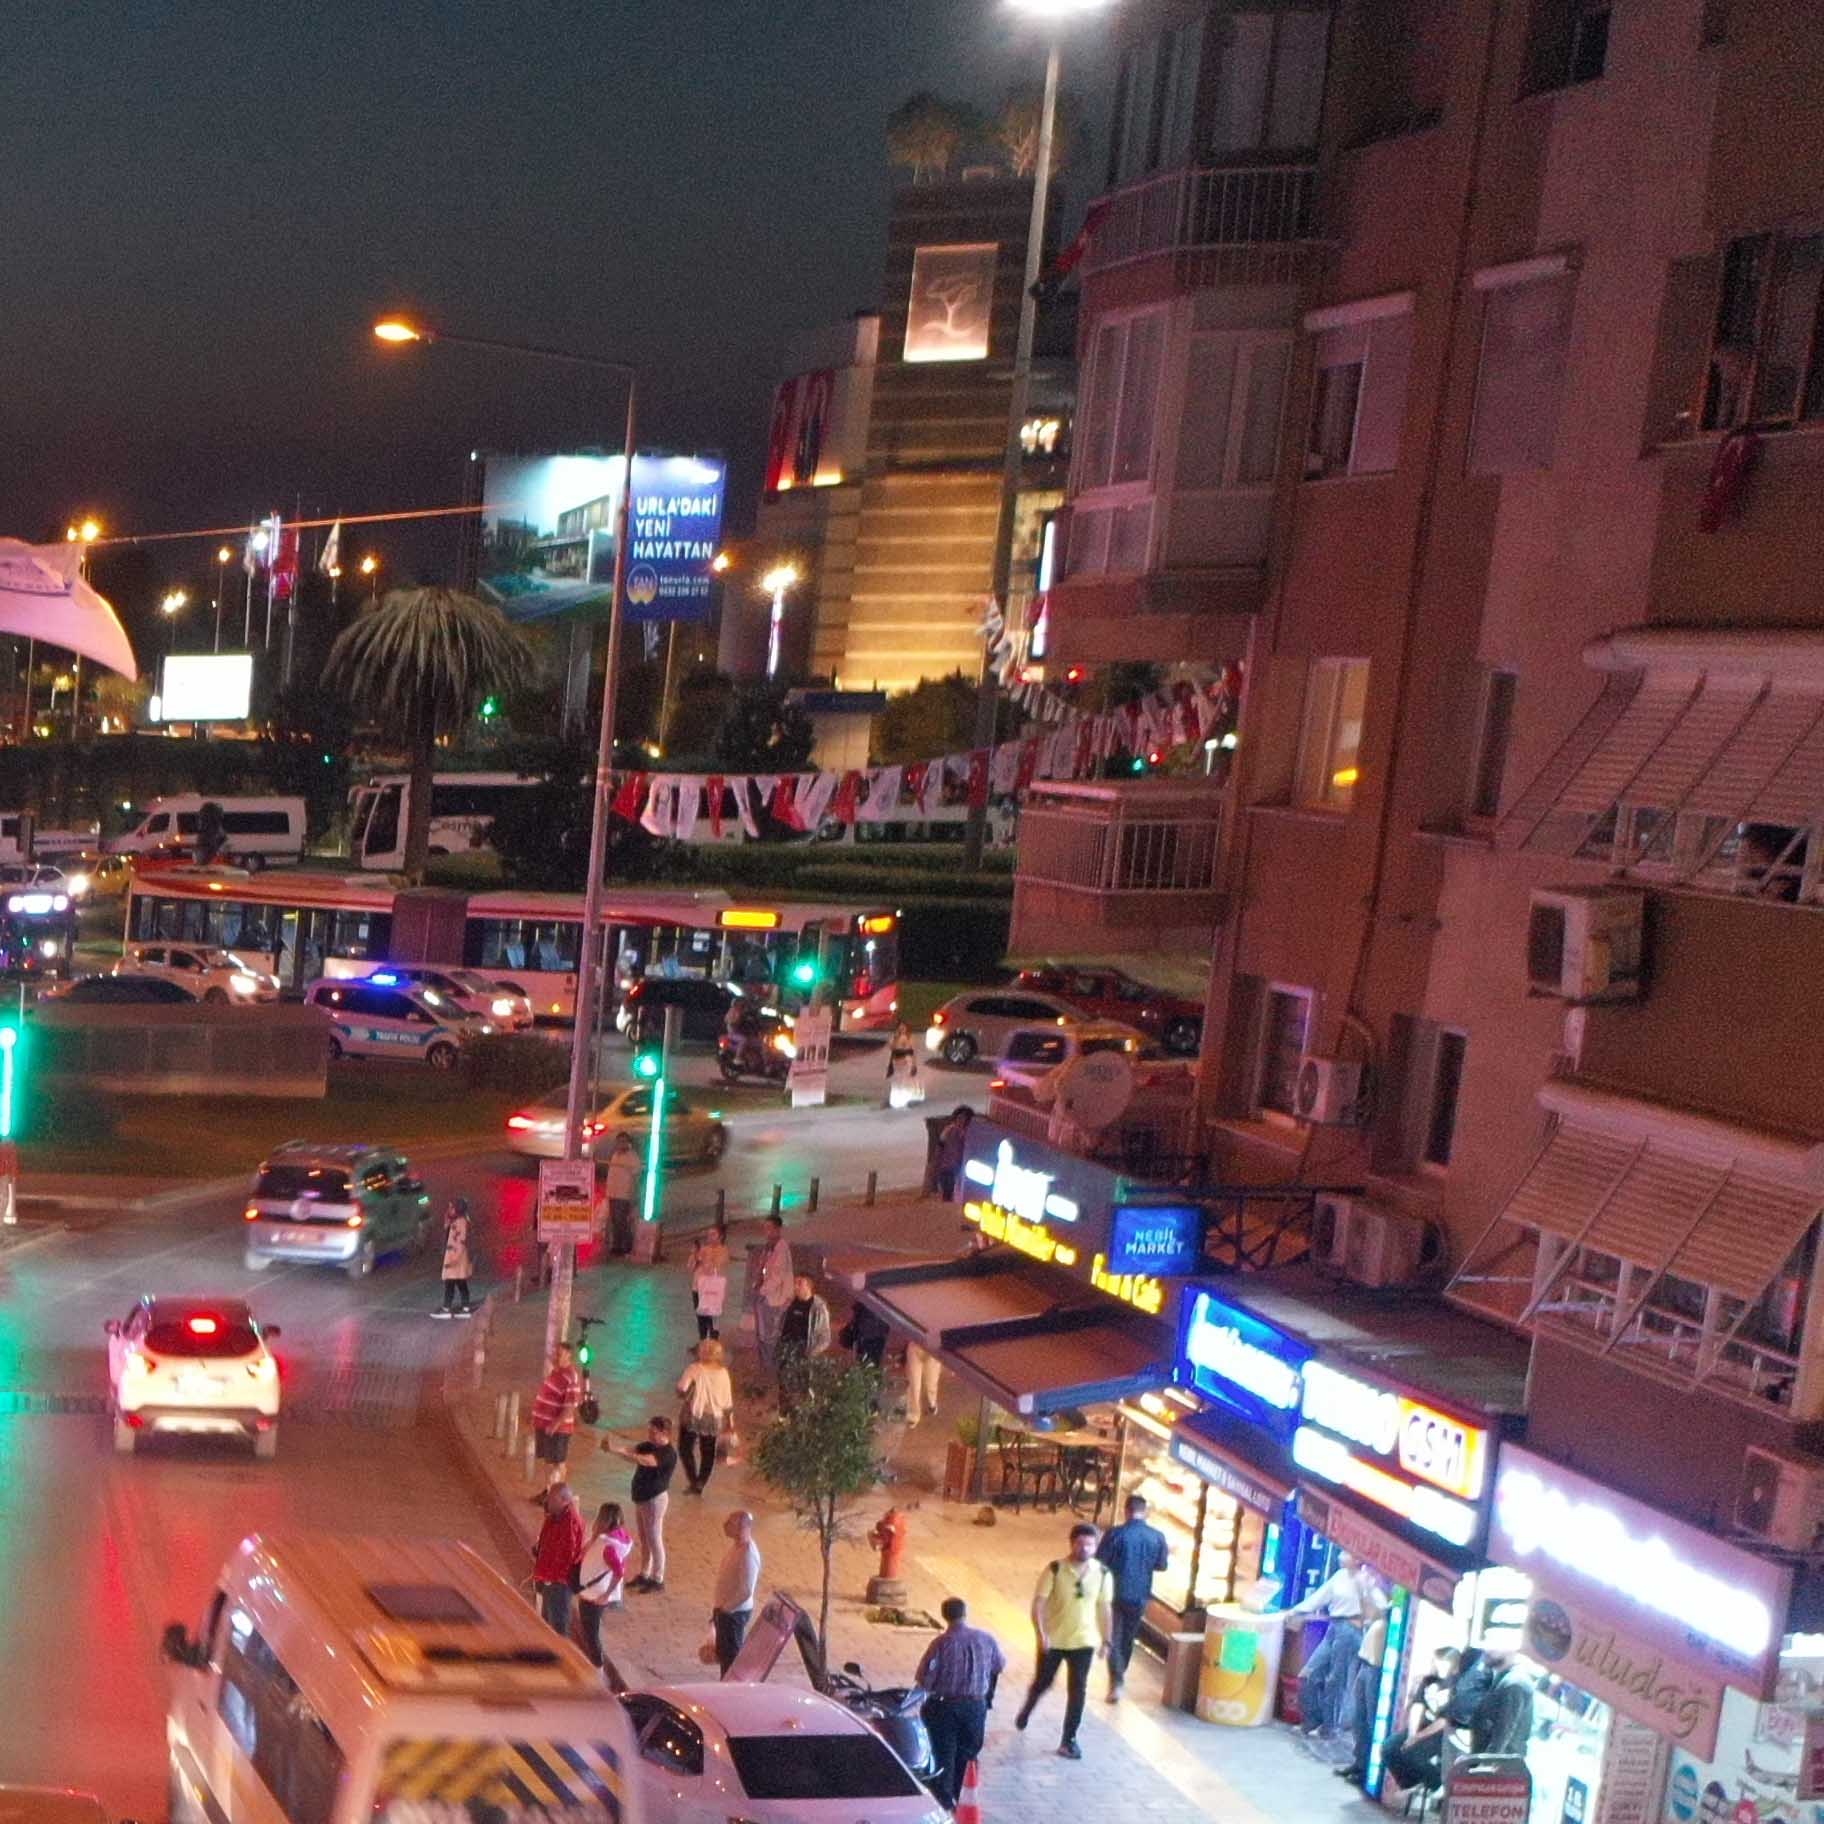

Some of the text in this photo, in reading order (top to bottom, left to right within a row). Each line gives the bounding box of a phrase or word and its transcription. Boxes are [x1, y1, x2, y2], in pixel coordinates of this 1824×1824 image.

[636, 494, 716, 517] URLA'DAKİ
[635, 514, 671, 537] YENİ
[633, 541, 713, 560] HAYATTAN
[1134, 1227, 1176, 1244] NEBİL
[1124, 1240, 1185, 1256] MARKET
[1573, 1632, 1710, 1739] uludağ
[1454, 1803, 1523, 1818] TELEFON
